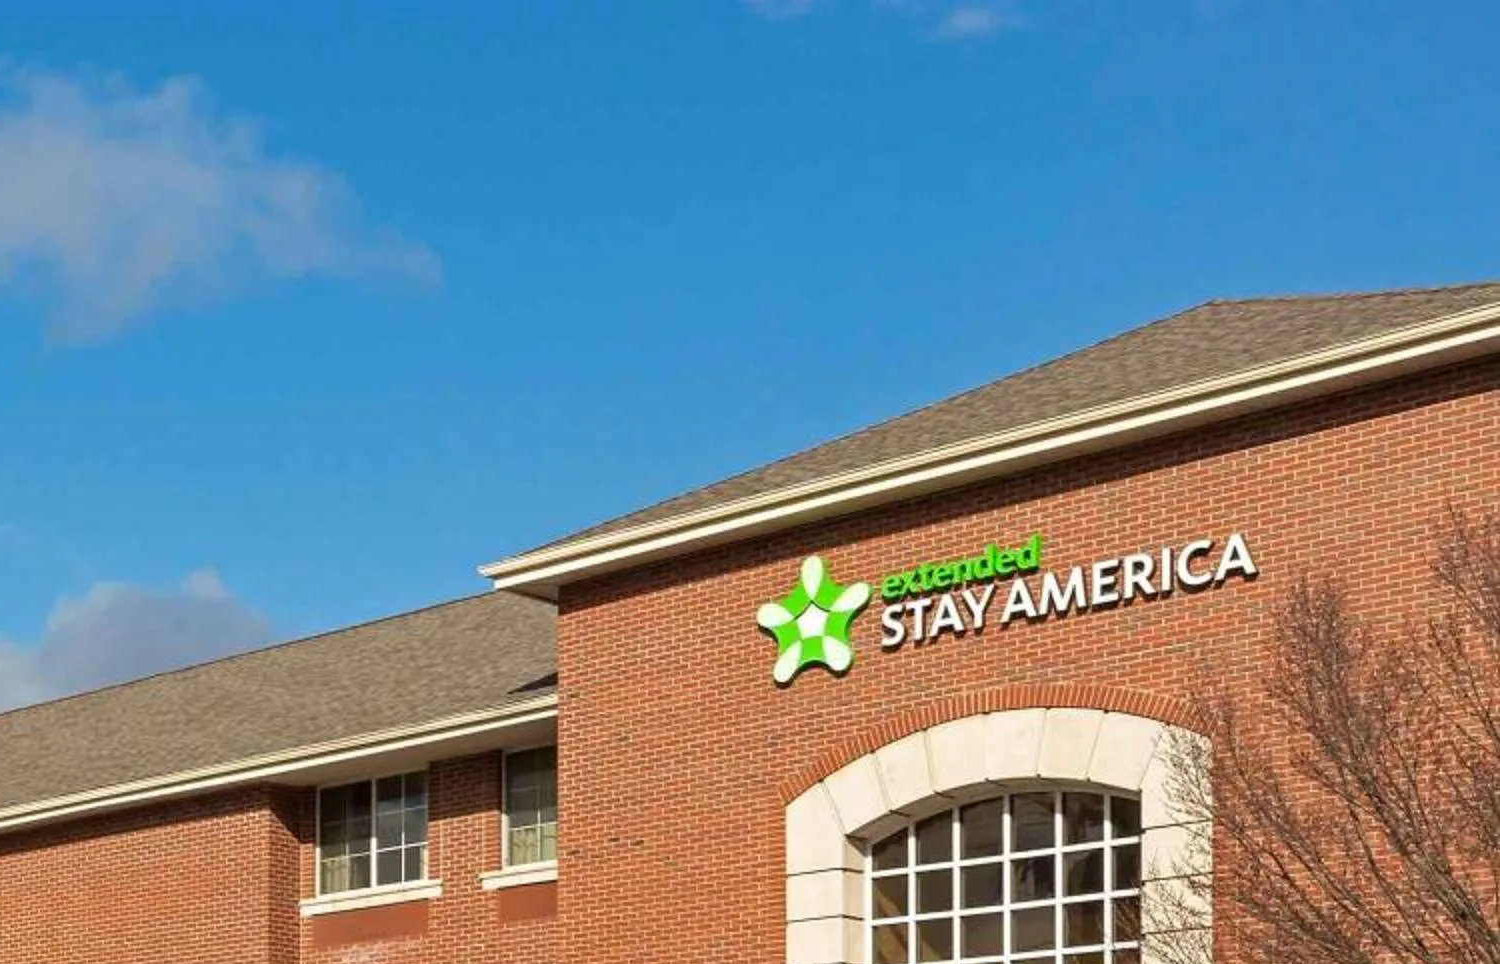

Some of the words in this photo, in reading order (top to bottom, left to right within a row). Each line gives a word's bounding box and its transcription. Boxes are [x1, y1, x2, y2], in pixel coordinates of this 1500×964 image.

[881, 583, 995, 647] STAY
[1000, 532, 1257, 624] AMERICA
[882, 531, 1043, 599] extended
